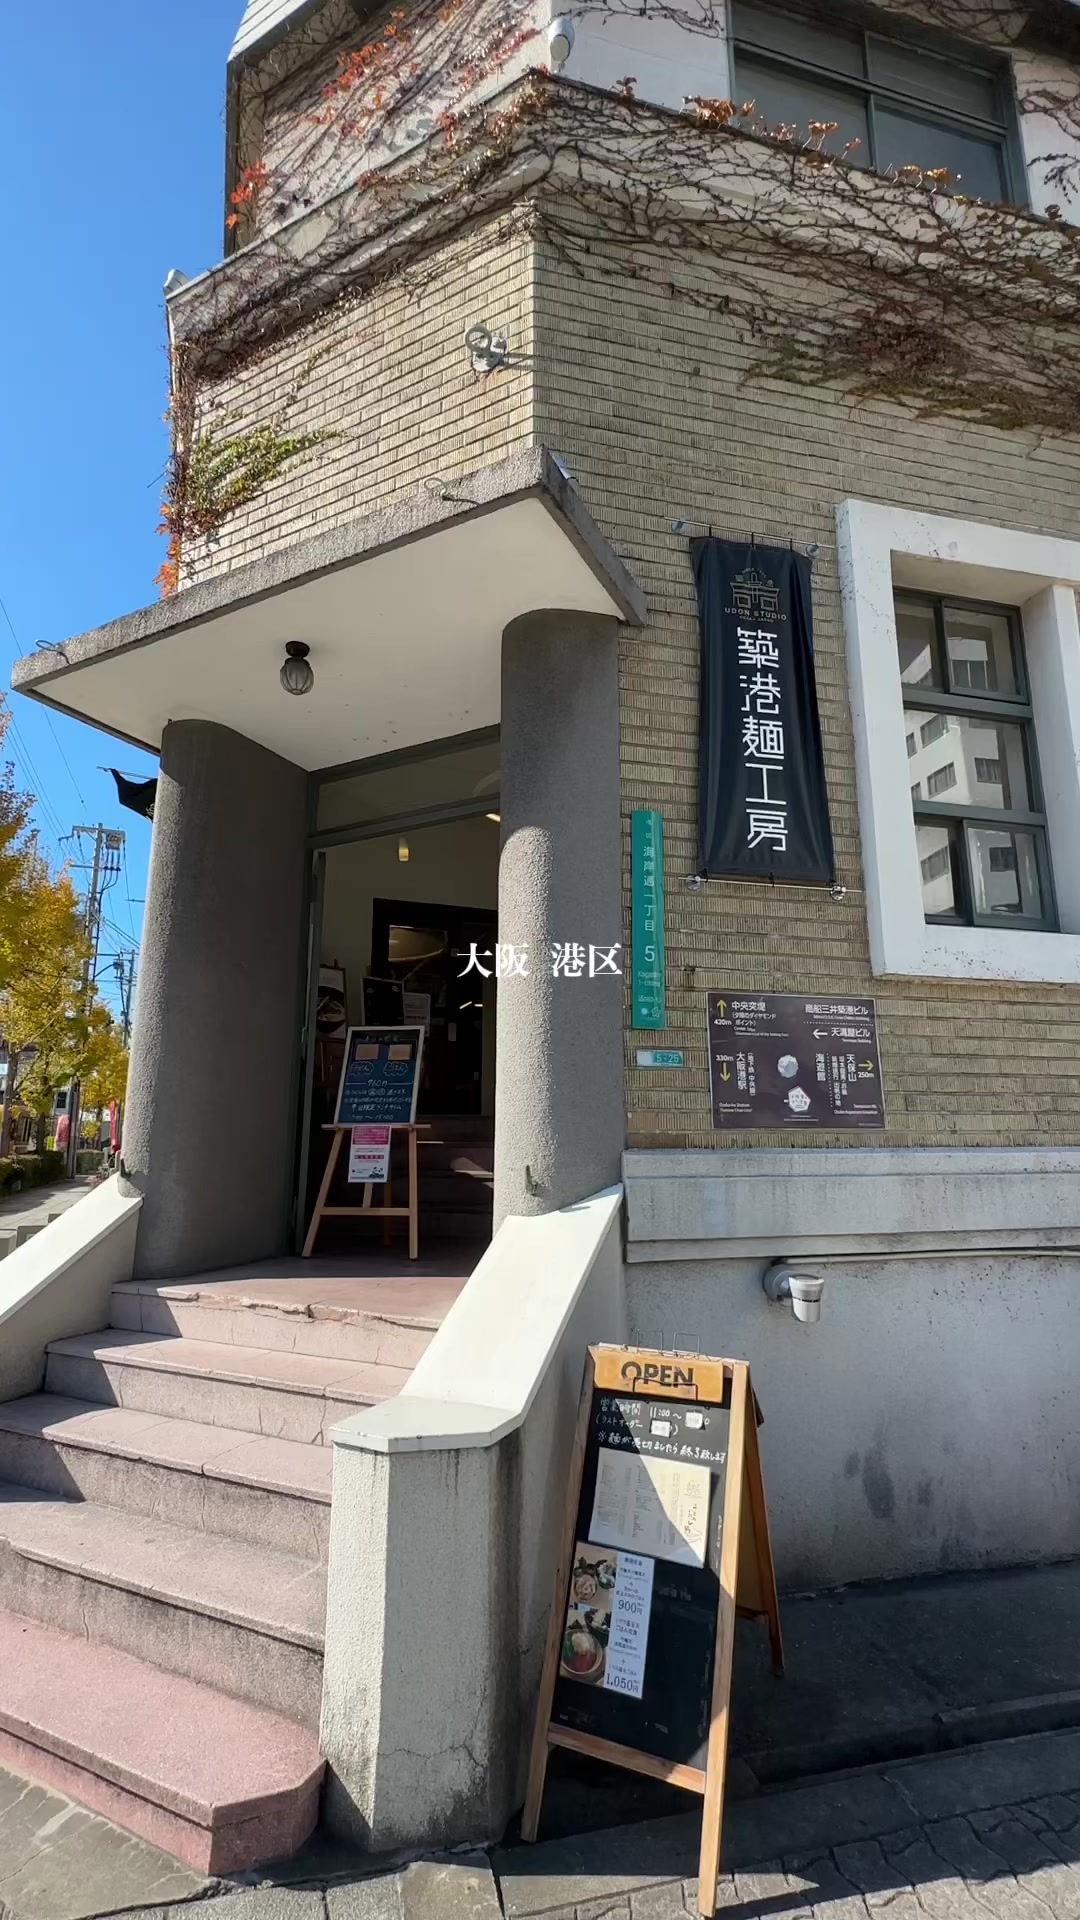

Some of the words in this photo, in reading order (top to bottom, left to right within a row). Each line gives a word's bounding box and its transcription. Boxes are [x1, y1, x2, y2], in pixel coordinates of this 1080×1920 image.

[724, 607, 750, 617] UDON
[754, 610, 787, 621] STUDIO
[736, 626, 789, 852] 築港麺工房
[644, 945, 655, 962] 5
[655, 1054, 679, 1064] 5-25
[716, 1054, 734, 1062] 330m
[736, 1052, 747, 1090] 大阪港駅
[846, 1054, 857, 1082] 天保山
[621, 1361, 694, 1388] OPEN
[650, 1406, 670, 1418] 11:00
